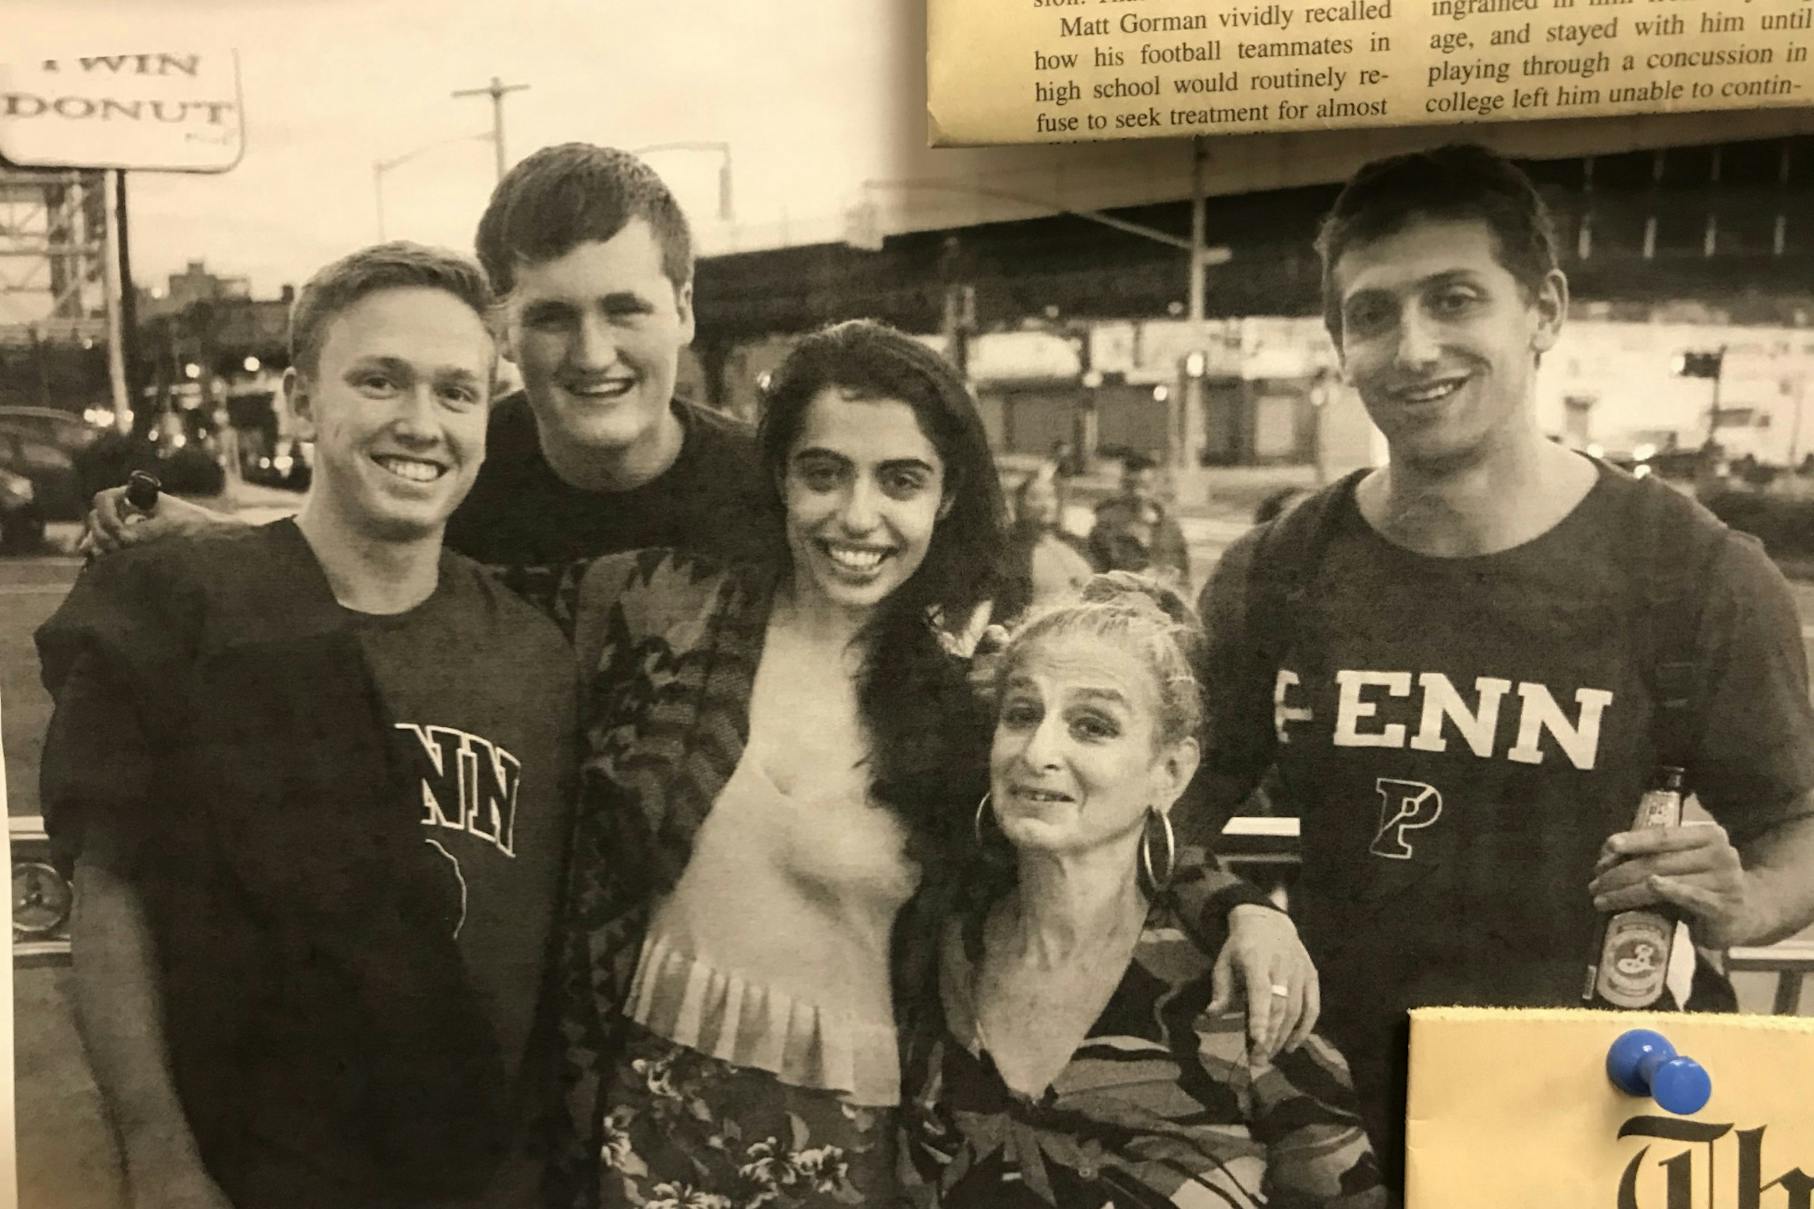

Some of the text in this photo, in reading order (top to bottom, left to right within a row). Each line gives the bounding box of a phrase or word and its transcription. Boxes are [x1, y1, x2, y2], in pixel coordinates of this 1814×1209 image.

[1060, 0, 1392, 37] Matt Gorman vividly recalled
[1430, 8, 1812, 54] age, and stayed with him until
[1034, 33, 1391, 70] how his football teammates in
[1427, 42, 1807, 87] playing through a concussion in
[1035, 67, 1389, 106] high school would routinely re-
[1425, 75, 1802, 114] college left him unable to contin-
[2, 93, 235, 125] DONUT
[1037, 98, 1388, 132] fuse to seek treatment for almost
